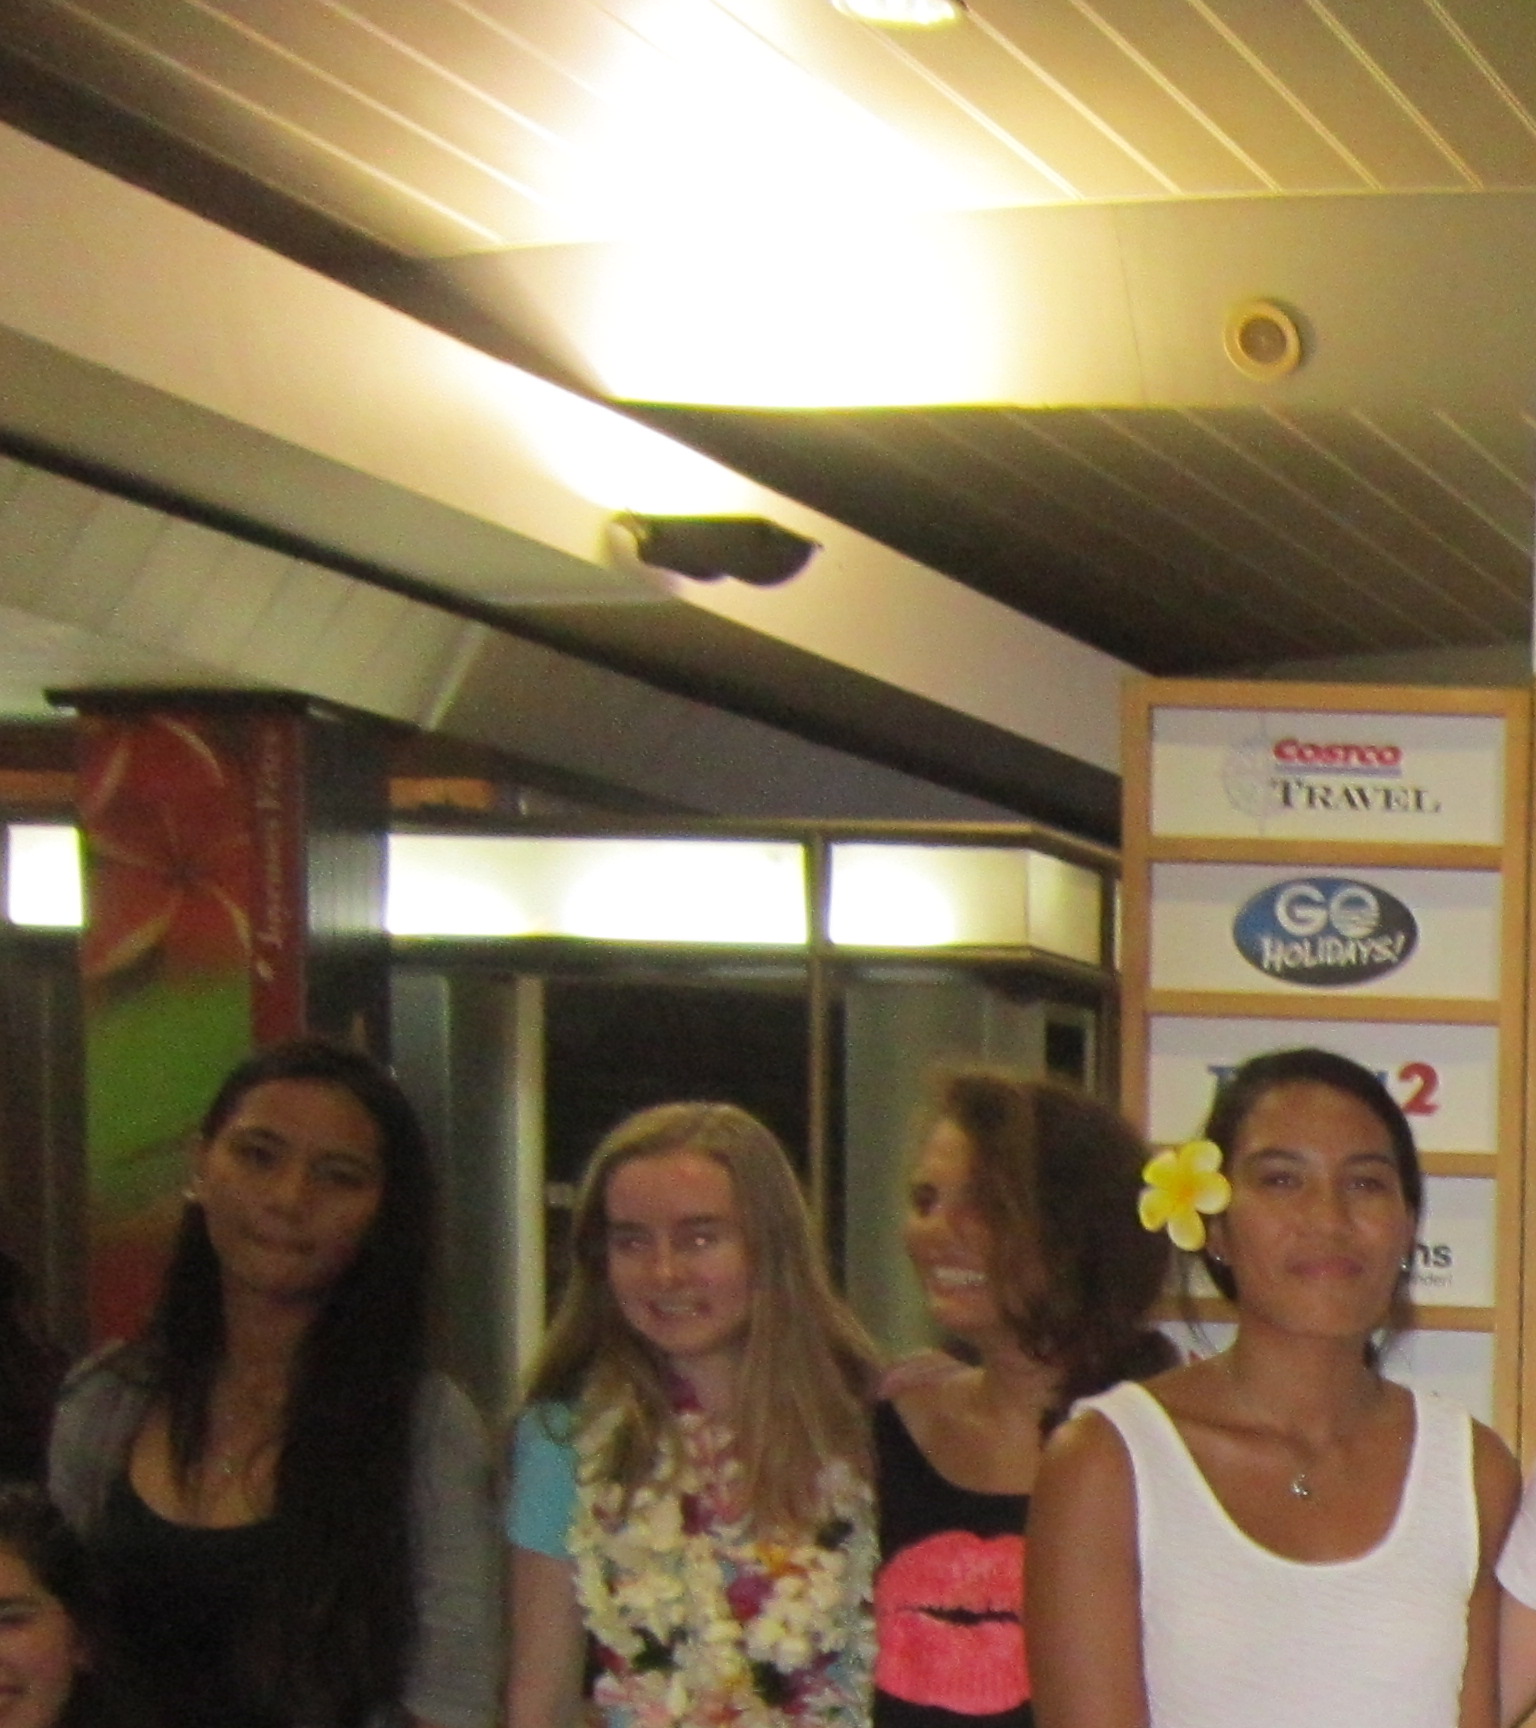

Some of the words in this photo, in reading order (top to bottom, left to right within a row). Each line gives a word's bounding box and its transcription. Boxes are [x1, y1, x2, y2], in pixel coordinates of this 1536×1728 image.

[1271, 777, 1441, 813] TRAVEL
[1275, 883, 1381, 939] GO
[1399, 1061, 1440, 1116] 2
[1414, 1243, 1454, 1269] ns
